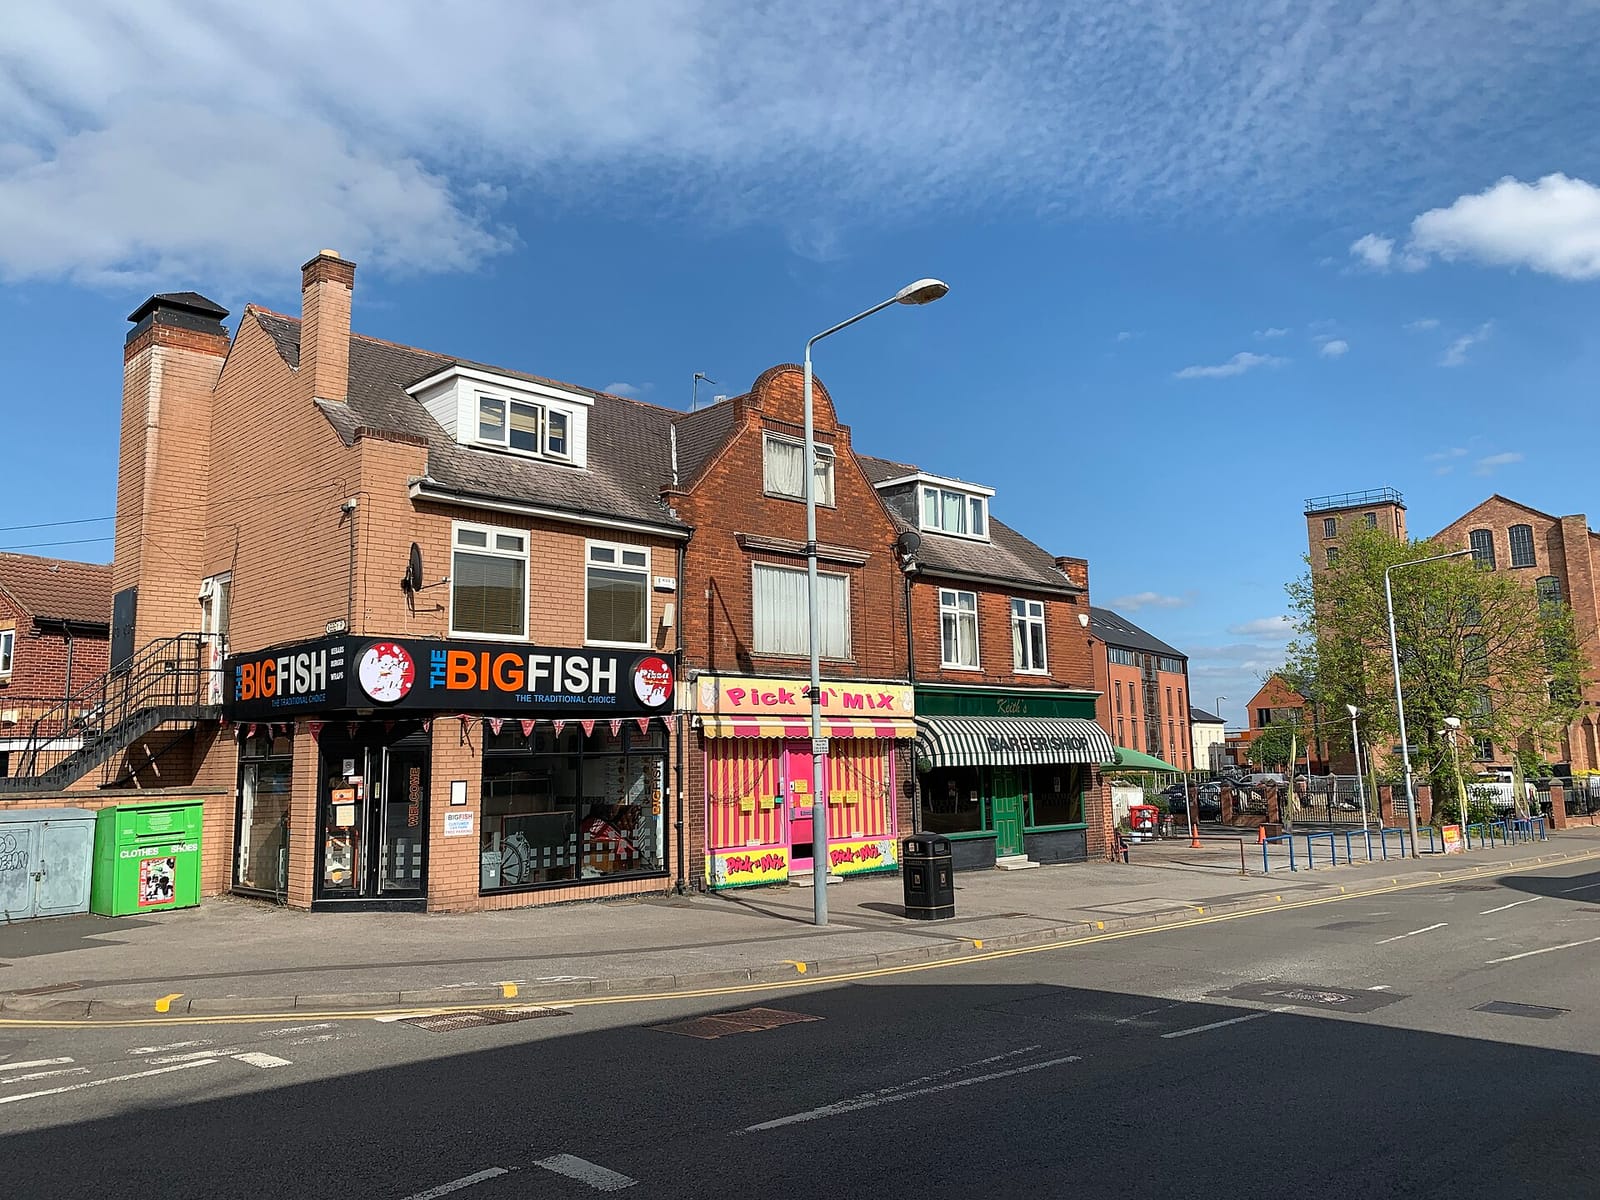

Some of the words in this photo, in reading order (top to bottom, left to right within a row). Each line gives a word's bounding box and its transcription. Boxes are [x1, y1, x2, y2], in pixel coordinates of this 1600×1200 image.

[430, 650, 447, 689] THE
[281, 694, 309, 706] TRADITIONAL
[309, 692, 327, 702] CHOICE
[515, 694, 532, 702] THE
[533, 695, 586, 704] TRADITIONAL
[588, 696, 616, 704] CHOICE
[726, 687, 796, 707] Pick
[997, 698, 1028, 714] Keith's
[408, 767, 421, 827] WELCOME
[120, 847, 159, 859] CLOTHES
[170, 843, 198, 853] SHOES
[829, 847, 855, 867] Pick
[860, 844, 882, 862] Mix
[725, 854, 753, 876] Pick
[761, 853, 786, 874] Mix
